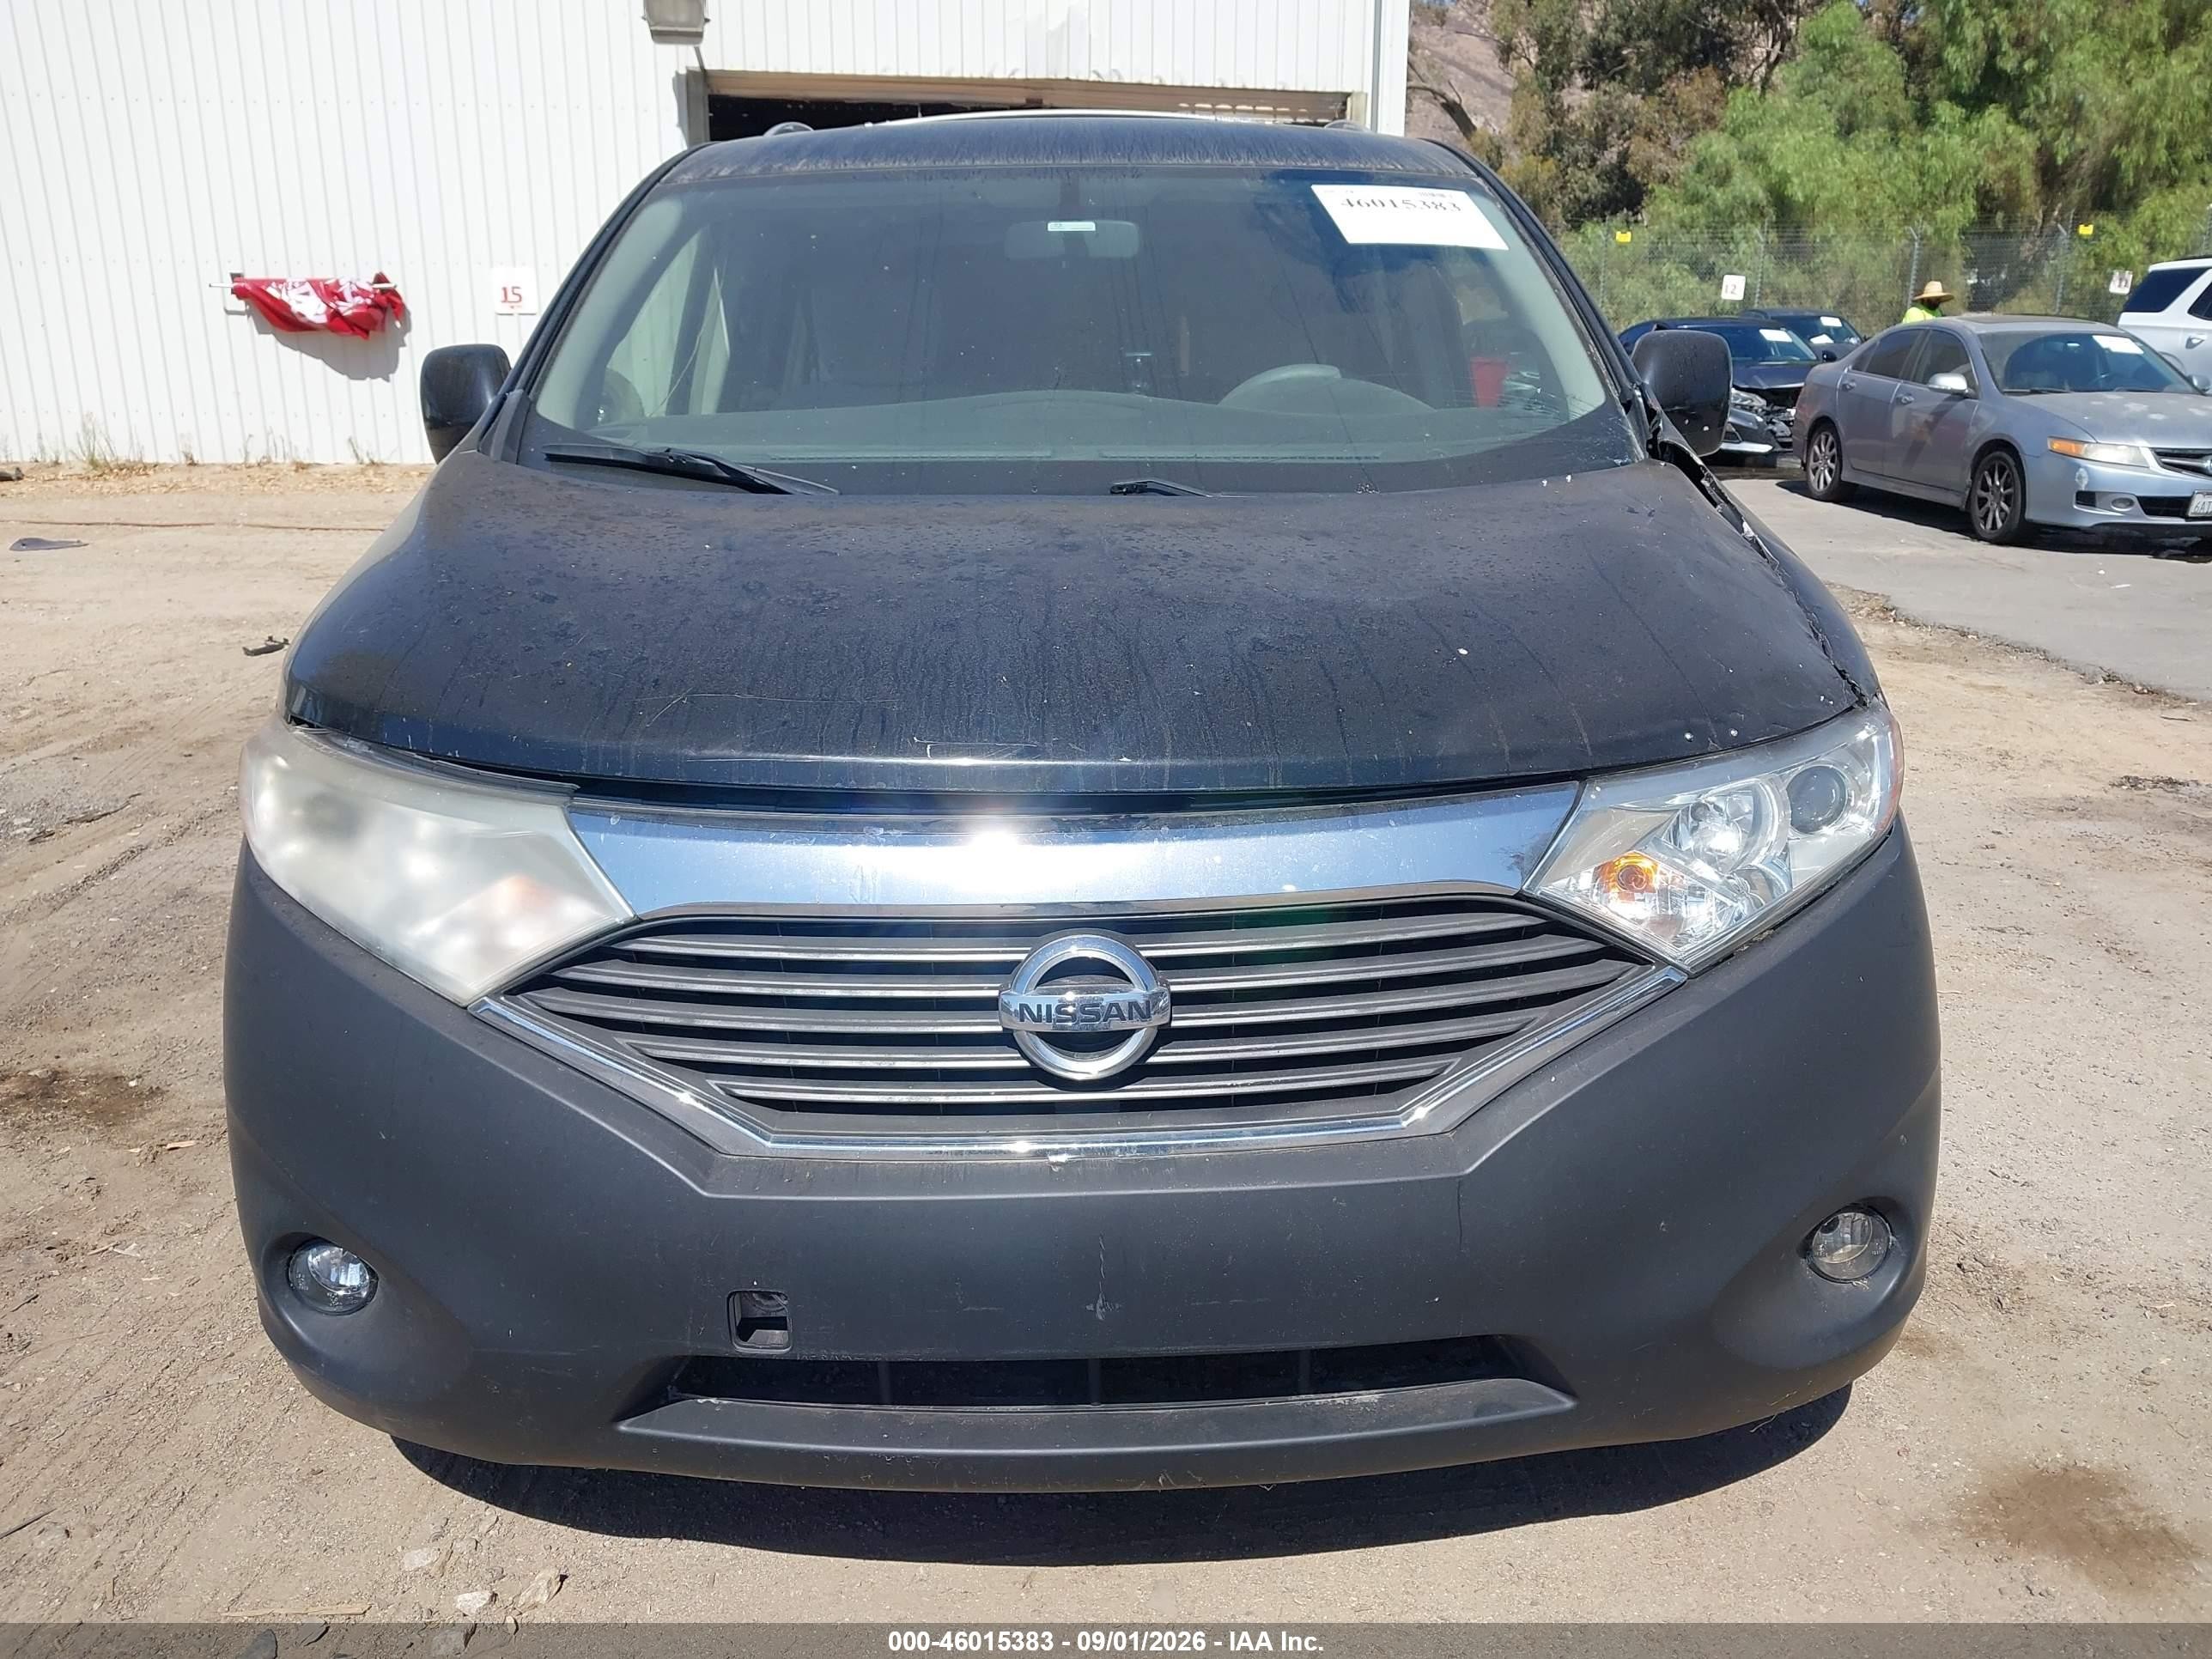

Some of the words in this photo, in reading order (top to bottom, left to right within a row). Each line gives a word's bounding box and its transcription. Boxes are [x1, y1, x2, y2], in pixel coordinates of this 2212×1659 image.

[1341, 198, 1462, 212] 46015383
[501, 286, 523, 303] 15
[1724, 283, 1737, 295] 12
[1018, 1000, 1152, 1024] NISSAN
